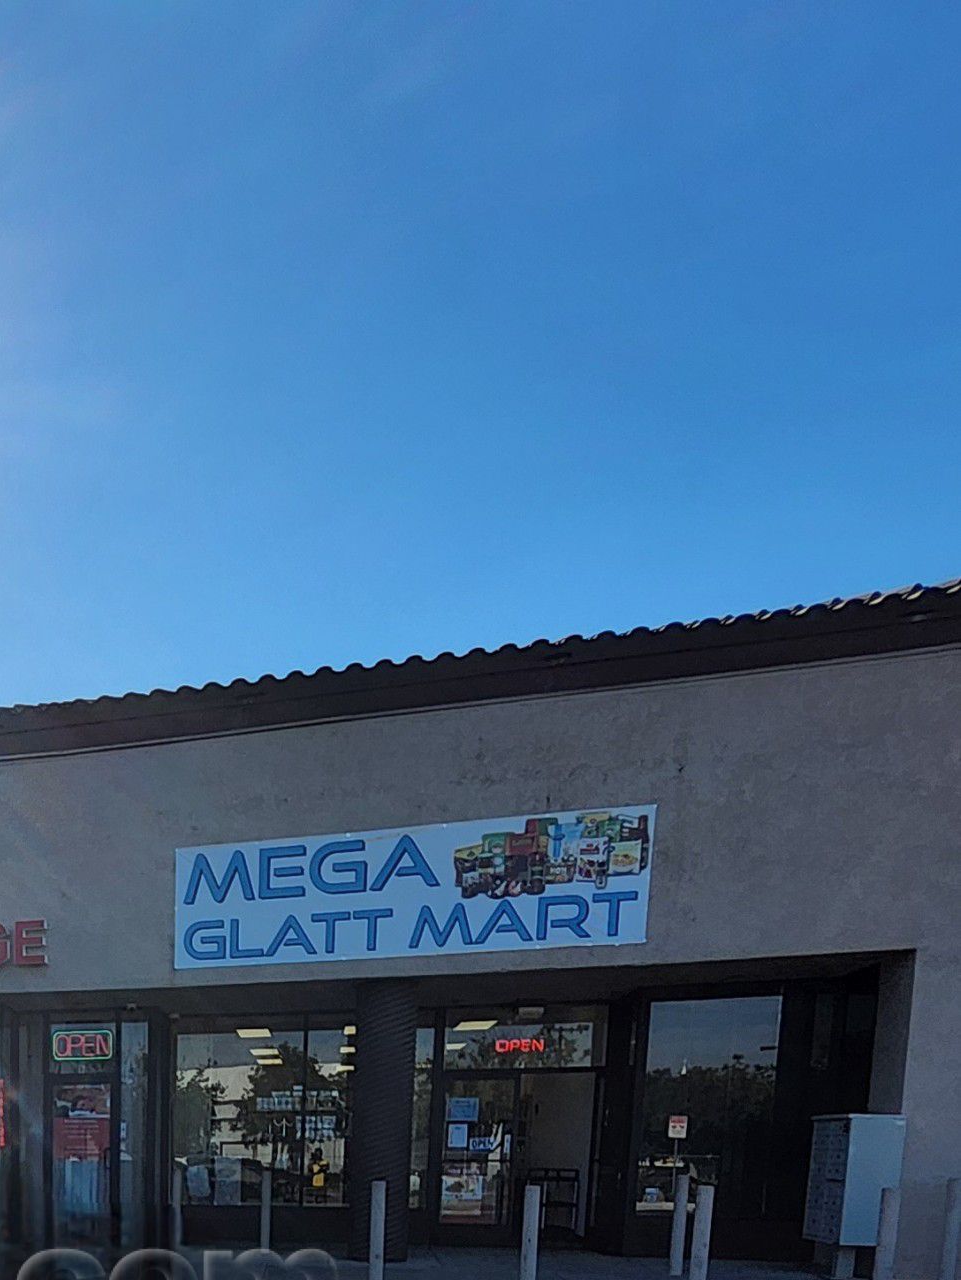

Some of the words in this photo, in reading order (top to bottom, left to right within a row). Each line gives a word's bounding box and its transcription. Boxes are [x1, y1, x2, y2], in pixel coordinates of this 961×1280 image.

[182, 834, 441, 905] MEGA
[183, 907, 394, 960] GLATT
[407, 889, 639, 950] MART
[56, 1033, 110, 1056] OPEN
[494, 1038, 545, 1053] OPEN
